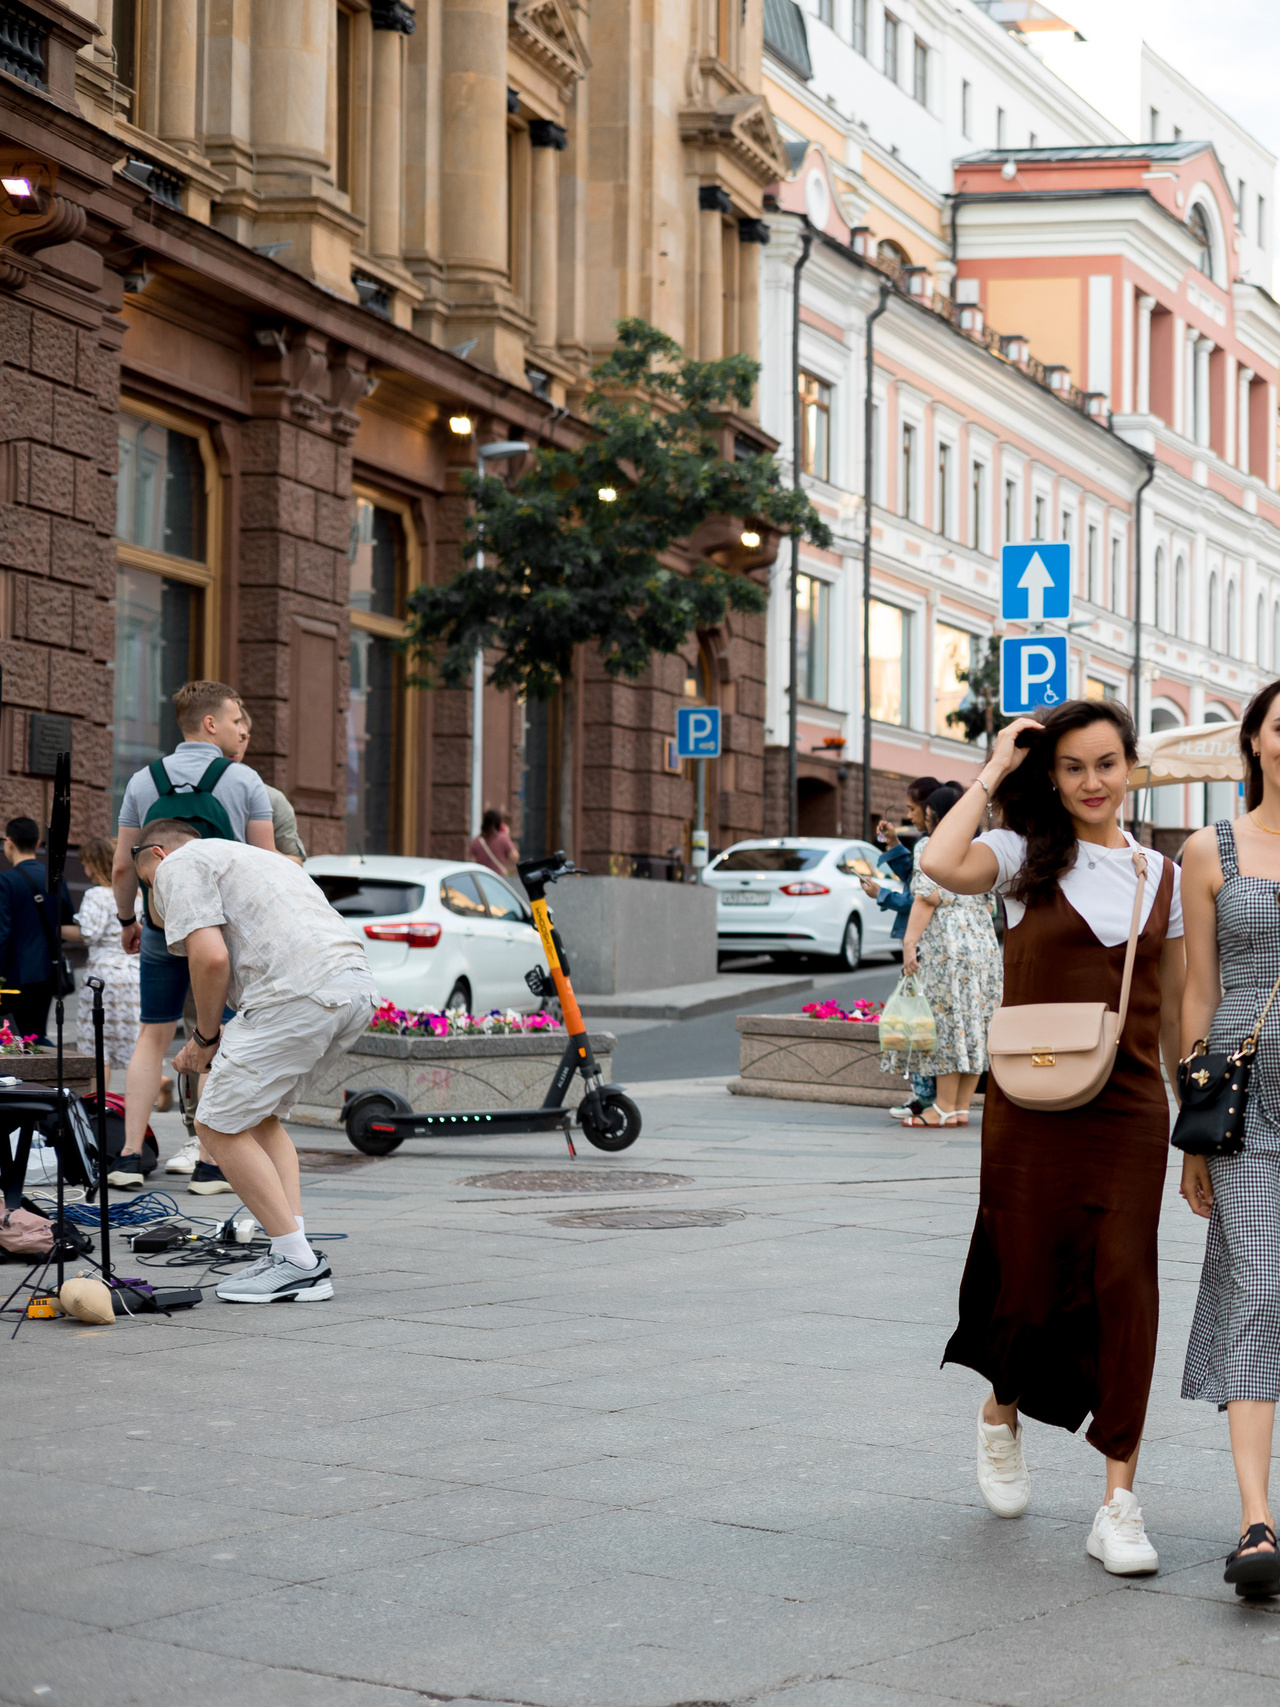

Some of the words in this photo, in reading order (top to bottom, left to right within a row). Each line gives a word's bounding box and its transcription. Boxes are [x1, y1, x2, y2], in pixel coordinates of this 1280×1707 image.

[1020, 645, 1056, 705] P
[689, 713, 712, 751] P
[535, 907, 550, 945] WHOOSH
